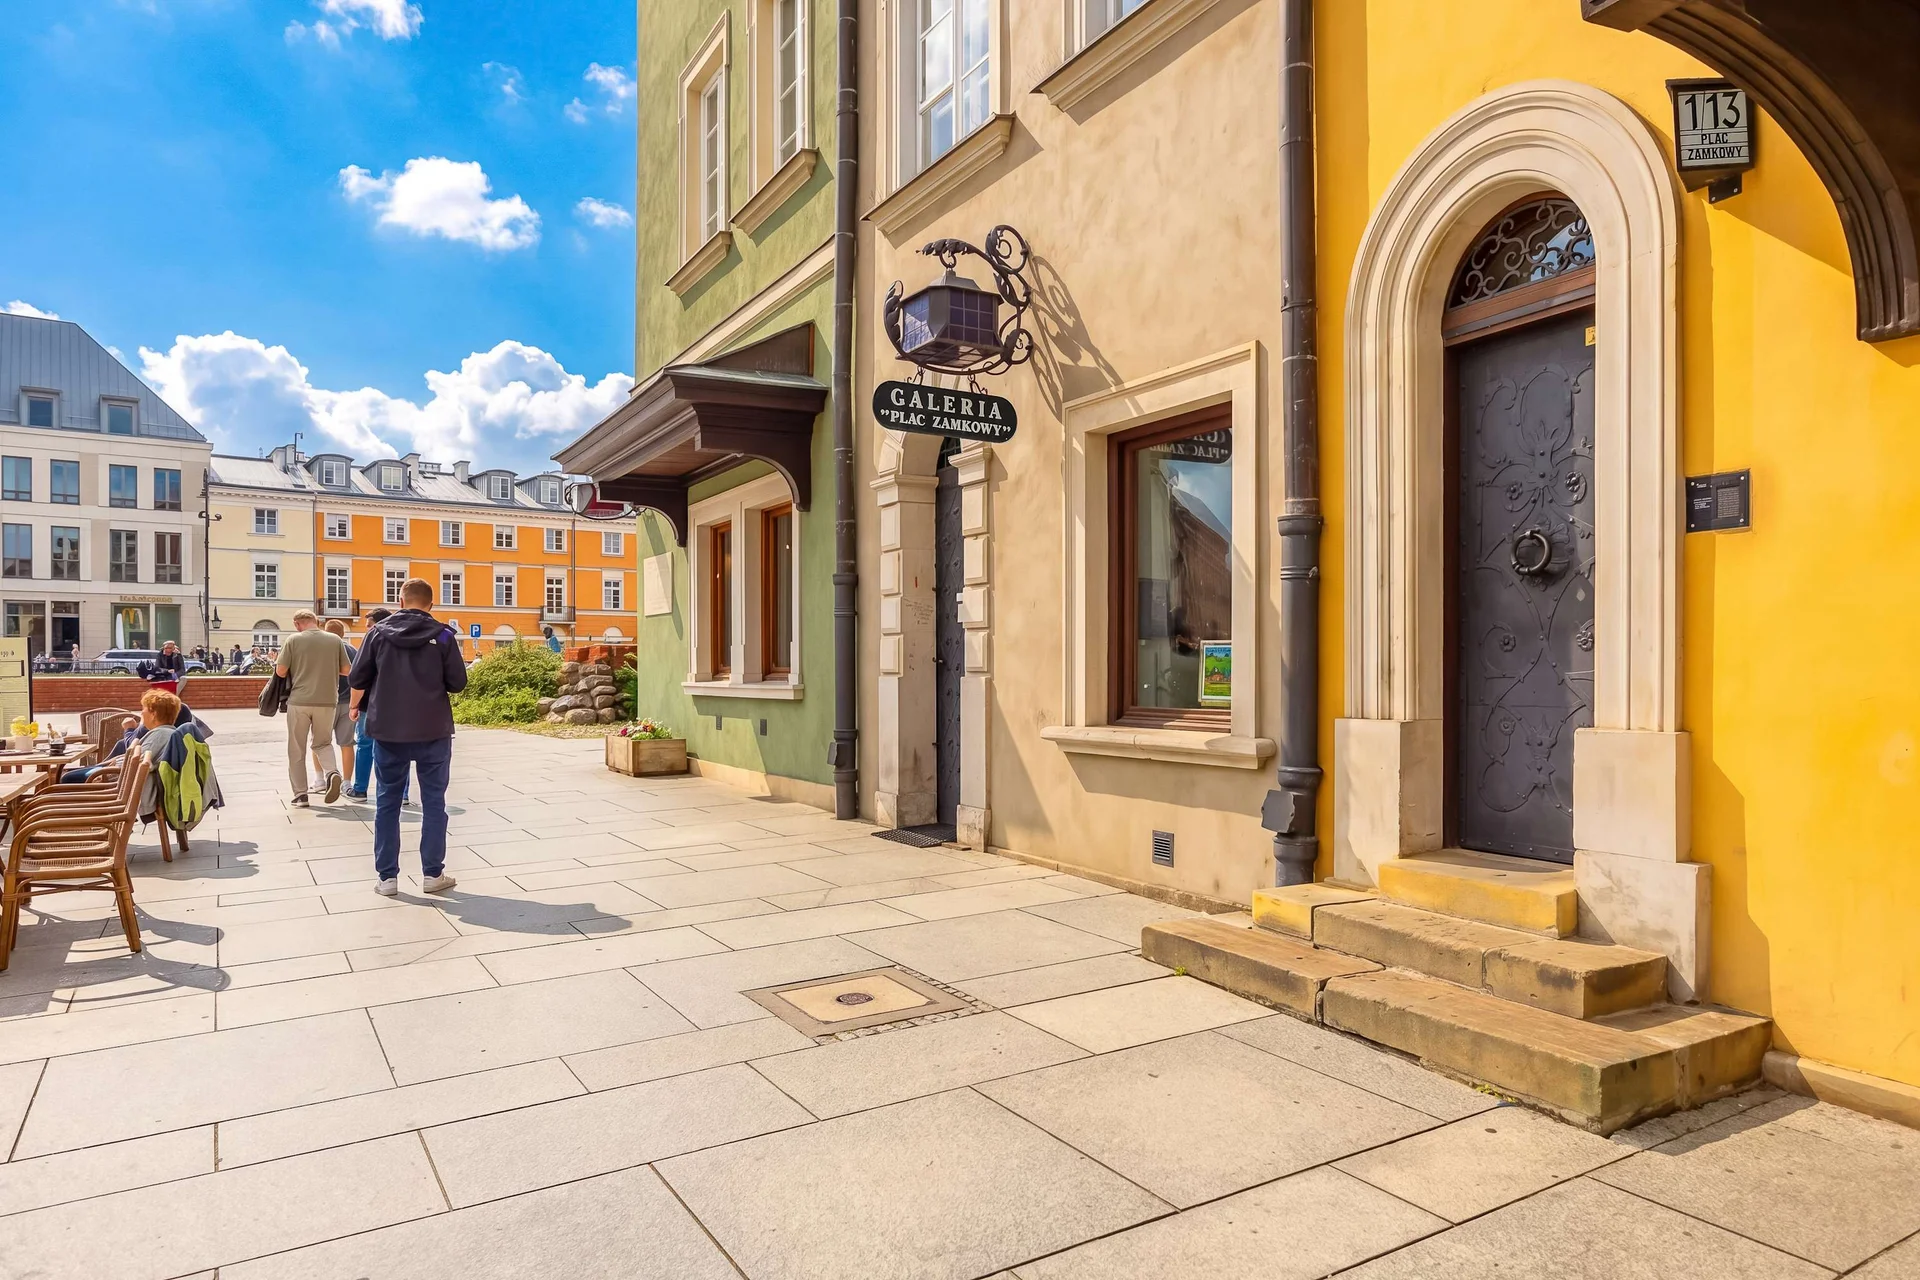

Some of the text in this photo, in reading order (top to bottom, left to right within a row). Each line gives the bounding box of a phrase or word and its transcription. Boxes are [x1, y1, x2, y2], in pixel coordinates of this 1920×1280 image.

[1701, 132, 1729, 145] PLAC
[1687, 146, 1742, 160] ZAMKOWY
[890, 388, 1003, 420] GALERIA
[472, 625, 480, 637] P
